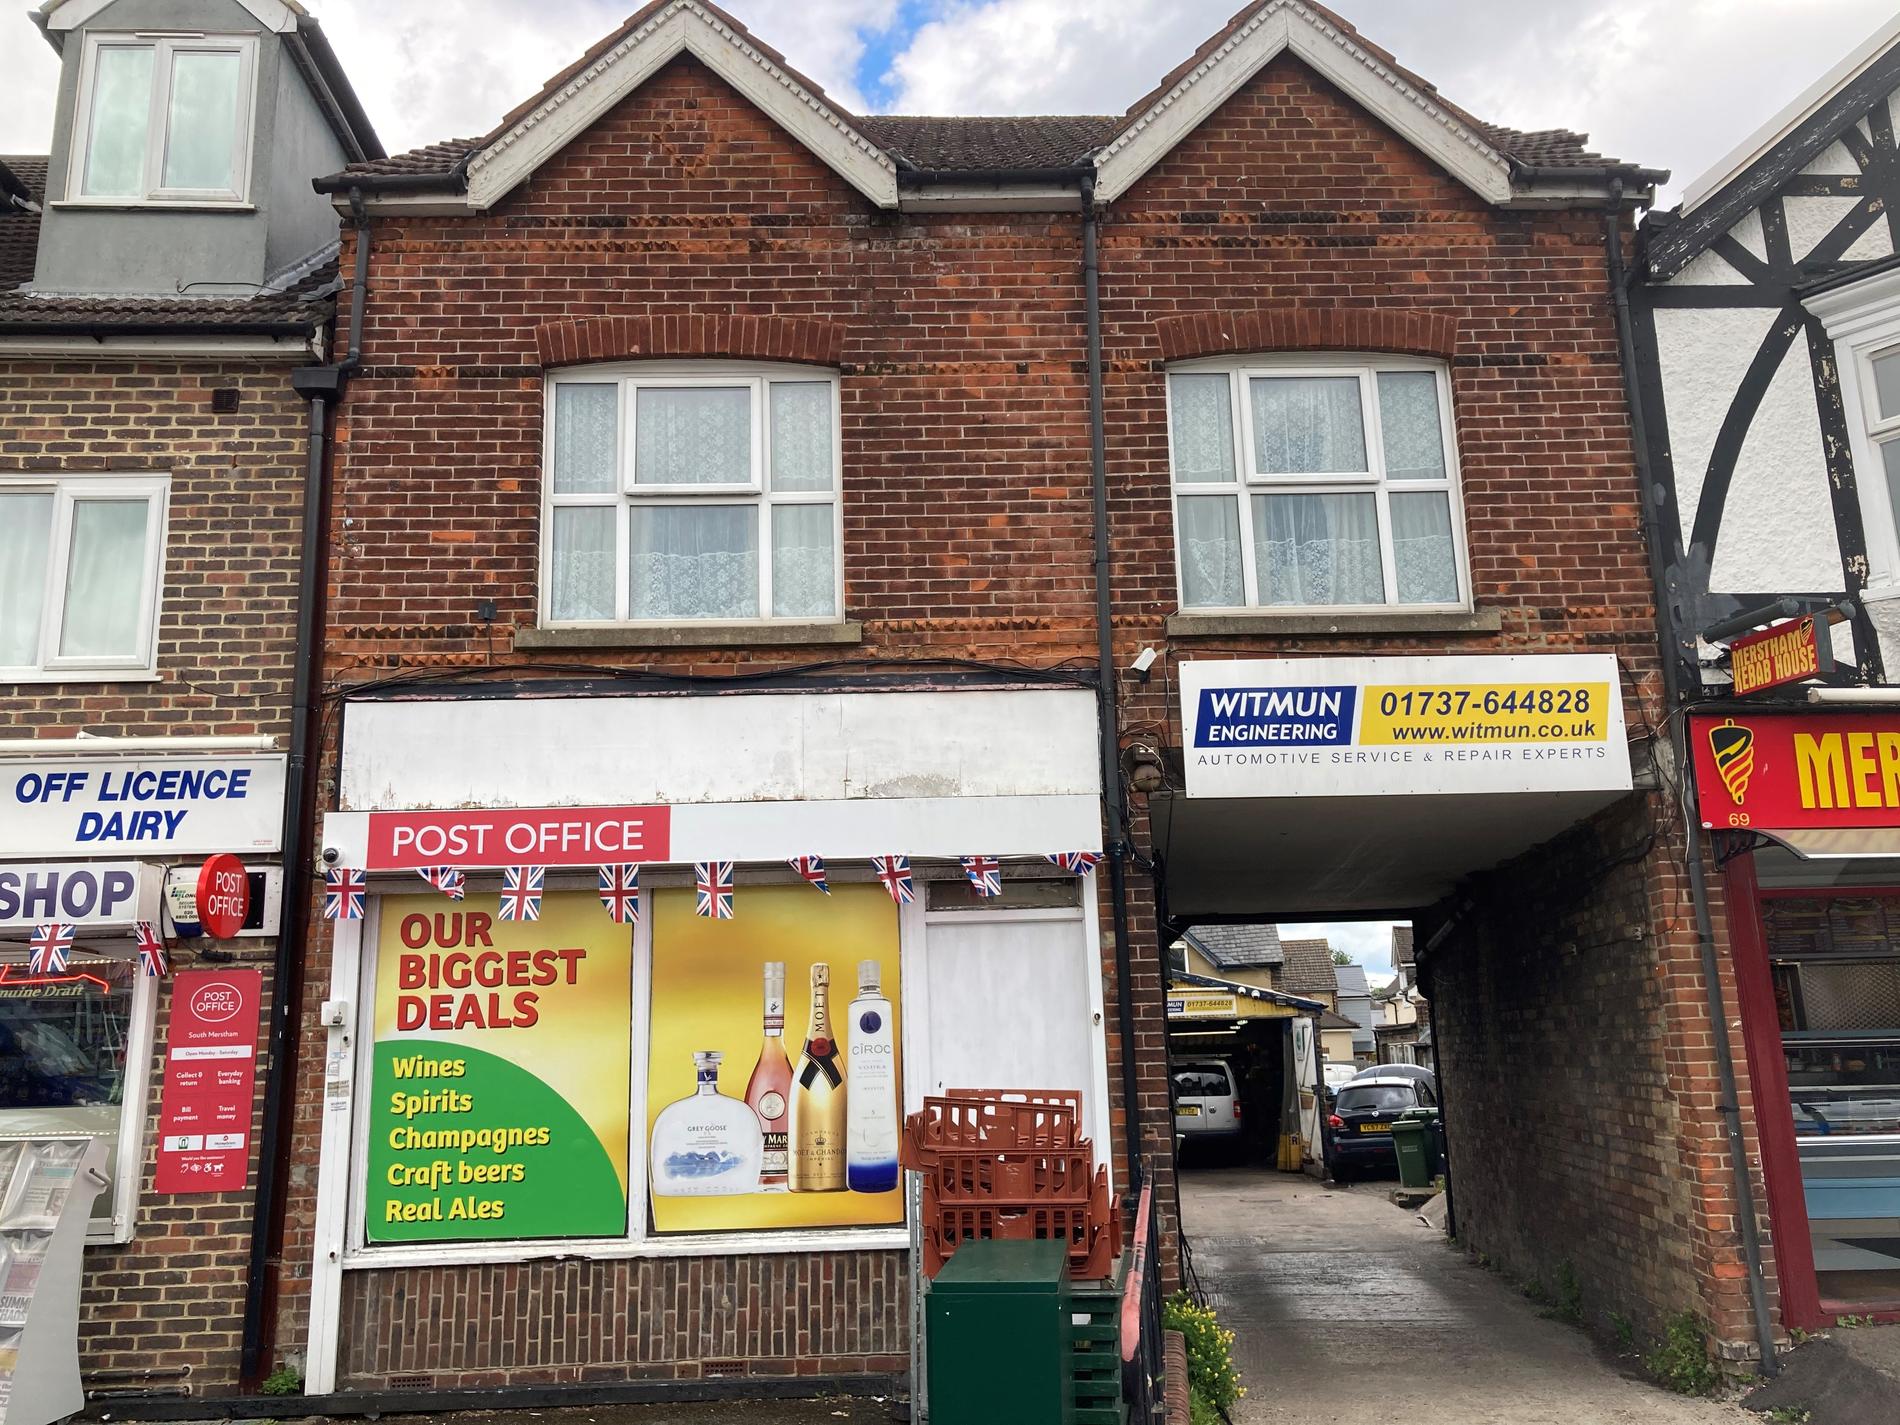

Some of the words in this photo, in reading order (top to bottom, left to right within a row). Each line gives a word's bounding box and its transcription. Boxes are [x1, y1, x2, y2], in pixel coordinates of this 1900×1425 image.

[1732, 630, 1801, 669] MERSTHAM
[1734, 659, 1772, 692] KEBAB
[1775, 644, 1817, 680] HOUSE
[1210, 690, 1342, 719] WITMUN
[1380, 688, 1591, 718] 01737-644828
[1208, 722, 1338, 743] ENGINEERING
[1392, 720, 1596, 741] www.witmun.co.uk
[1197, 752, 1321, 766] AUTOMOTIVE
[1331, 750, 1414, 764] SERVICE
[1423, 752, 1433, 763] &
[1444, 748, 1513, 761] REPAIR
[1522, 746, 1606, 760] EXPERTS
[15, 772, 89, 803] OFF
[97, 769, 251, 801] LICENCE
[75, 809, 189, 842] DAIRY
[1728, 813, 1750, 826] 69
[392, 824, 494, 857] POST
[505, 820, 644, 854] OFFICE
[0, 870, 135, 920] SHOP
[215, 870, 243, 891] POST
[208, 895, 244, 917] OFFICE
[400, 911, 493, 949] OUR
[398, 948, 587, 990] BIGGEST
[43, 984, 84, 997] Draft
[204, 991, 232, 1001] POST
[197, 1002, 235, 1012] OFFICE
[396, 991, 540, 1031] DEALS
[208, 1030, 238, 1038] Merstham
[391, 1055, 467, 1079] Wines
[173, 1114, 198, 1122] payment
[389, 1089, 473, 1119] Spirits
[388, 1125, 551, 1154] Champagnes
[387, 1160, 453, 1190] Craft
[458, 1160, 526, 1184] beers
[385, 1197, 444, 1223] Real
[448, 1195, 505, 1221] Ales
